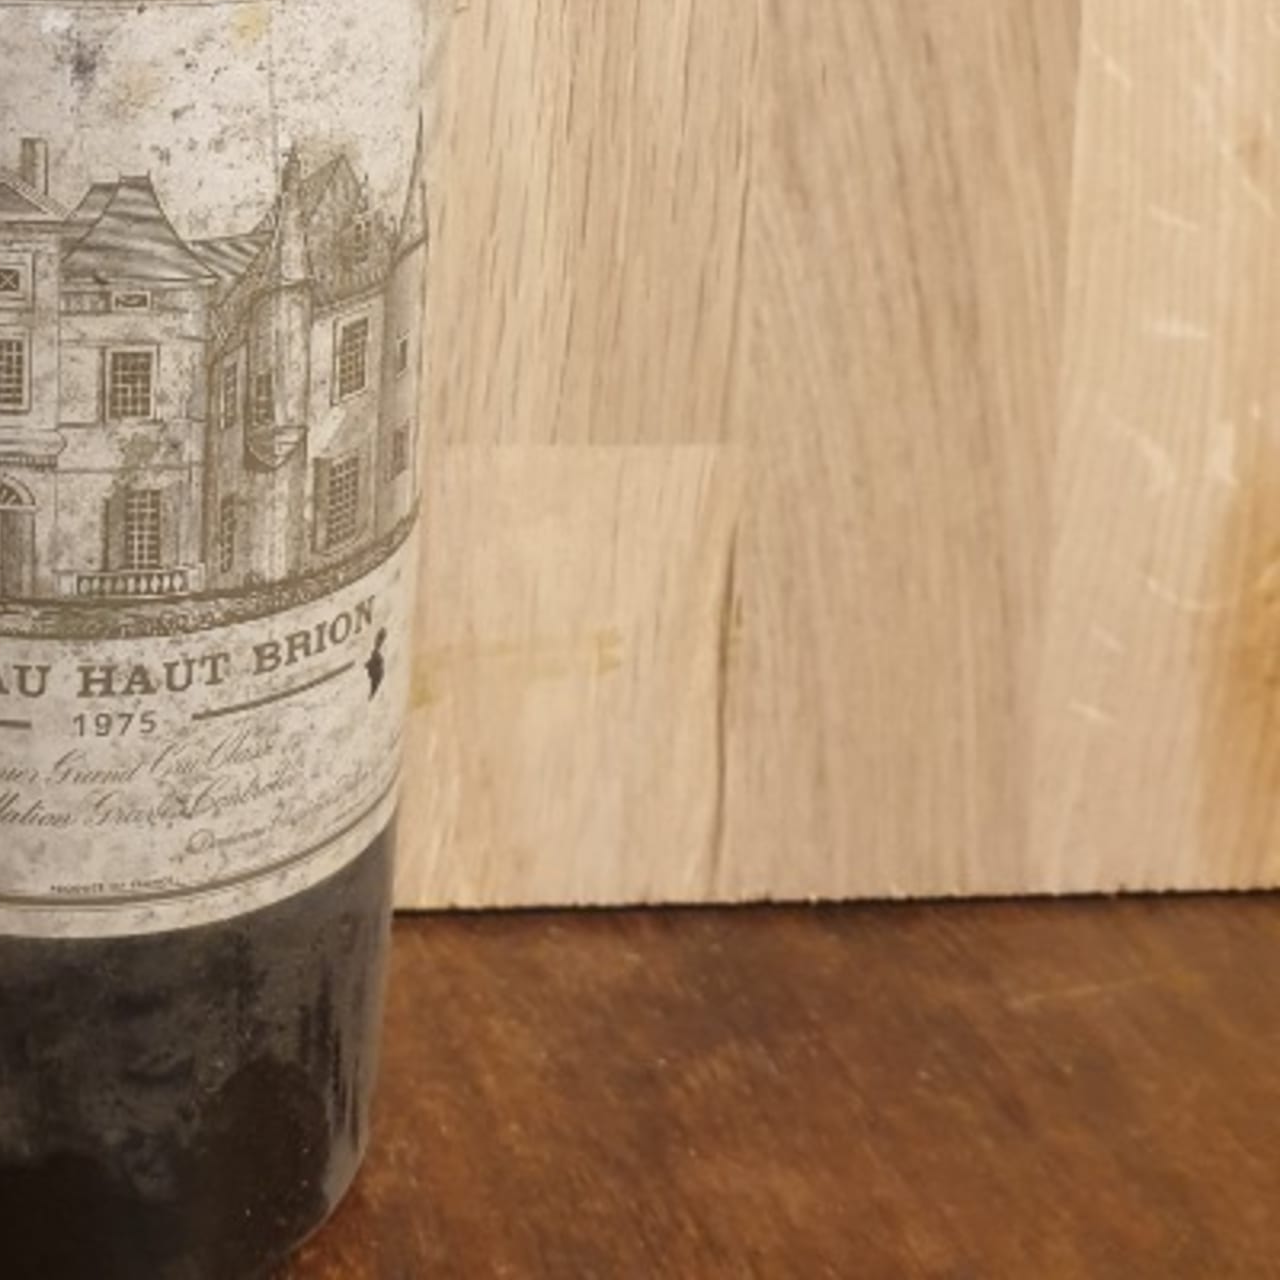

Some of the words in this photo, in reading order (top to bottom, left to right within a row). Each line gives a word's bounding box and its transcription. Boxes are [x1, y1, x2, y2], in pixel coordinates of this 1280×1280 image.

[76, 652, 230, 698] HAUT
[252, 594, 376, 675] BRION
[73, 710, 157, 737] 1975
[51, 748, 146, 785] Grand
